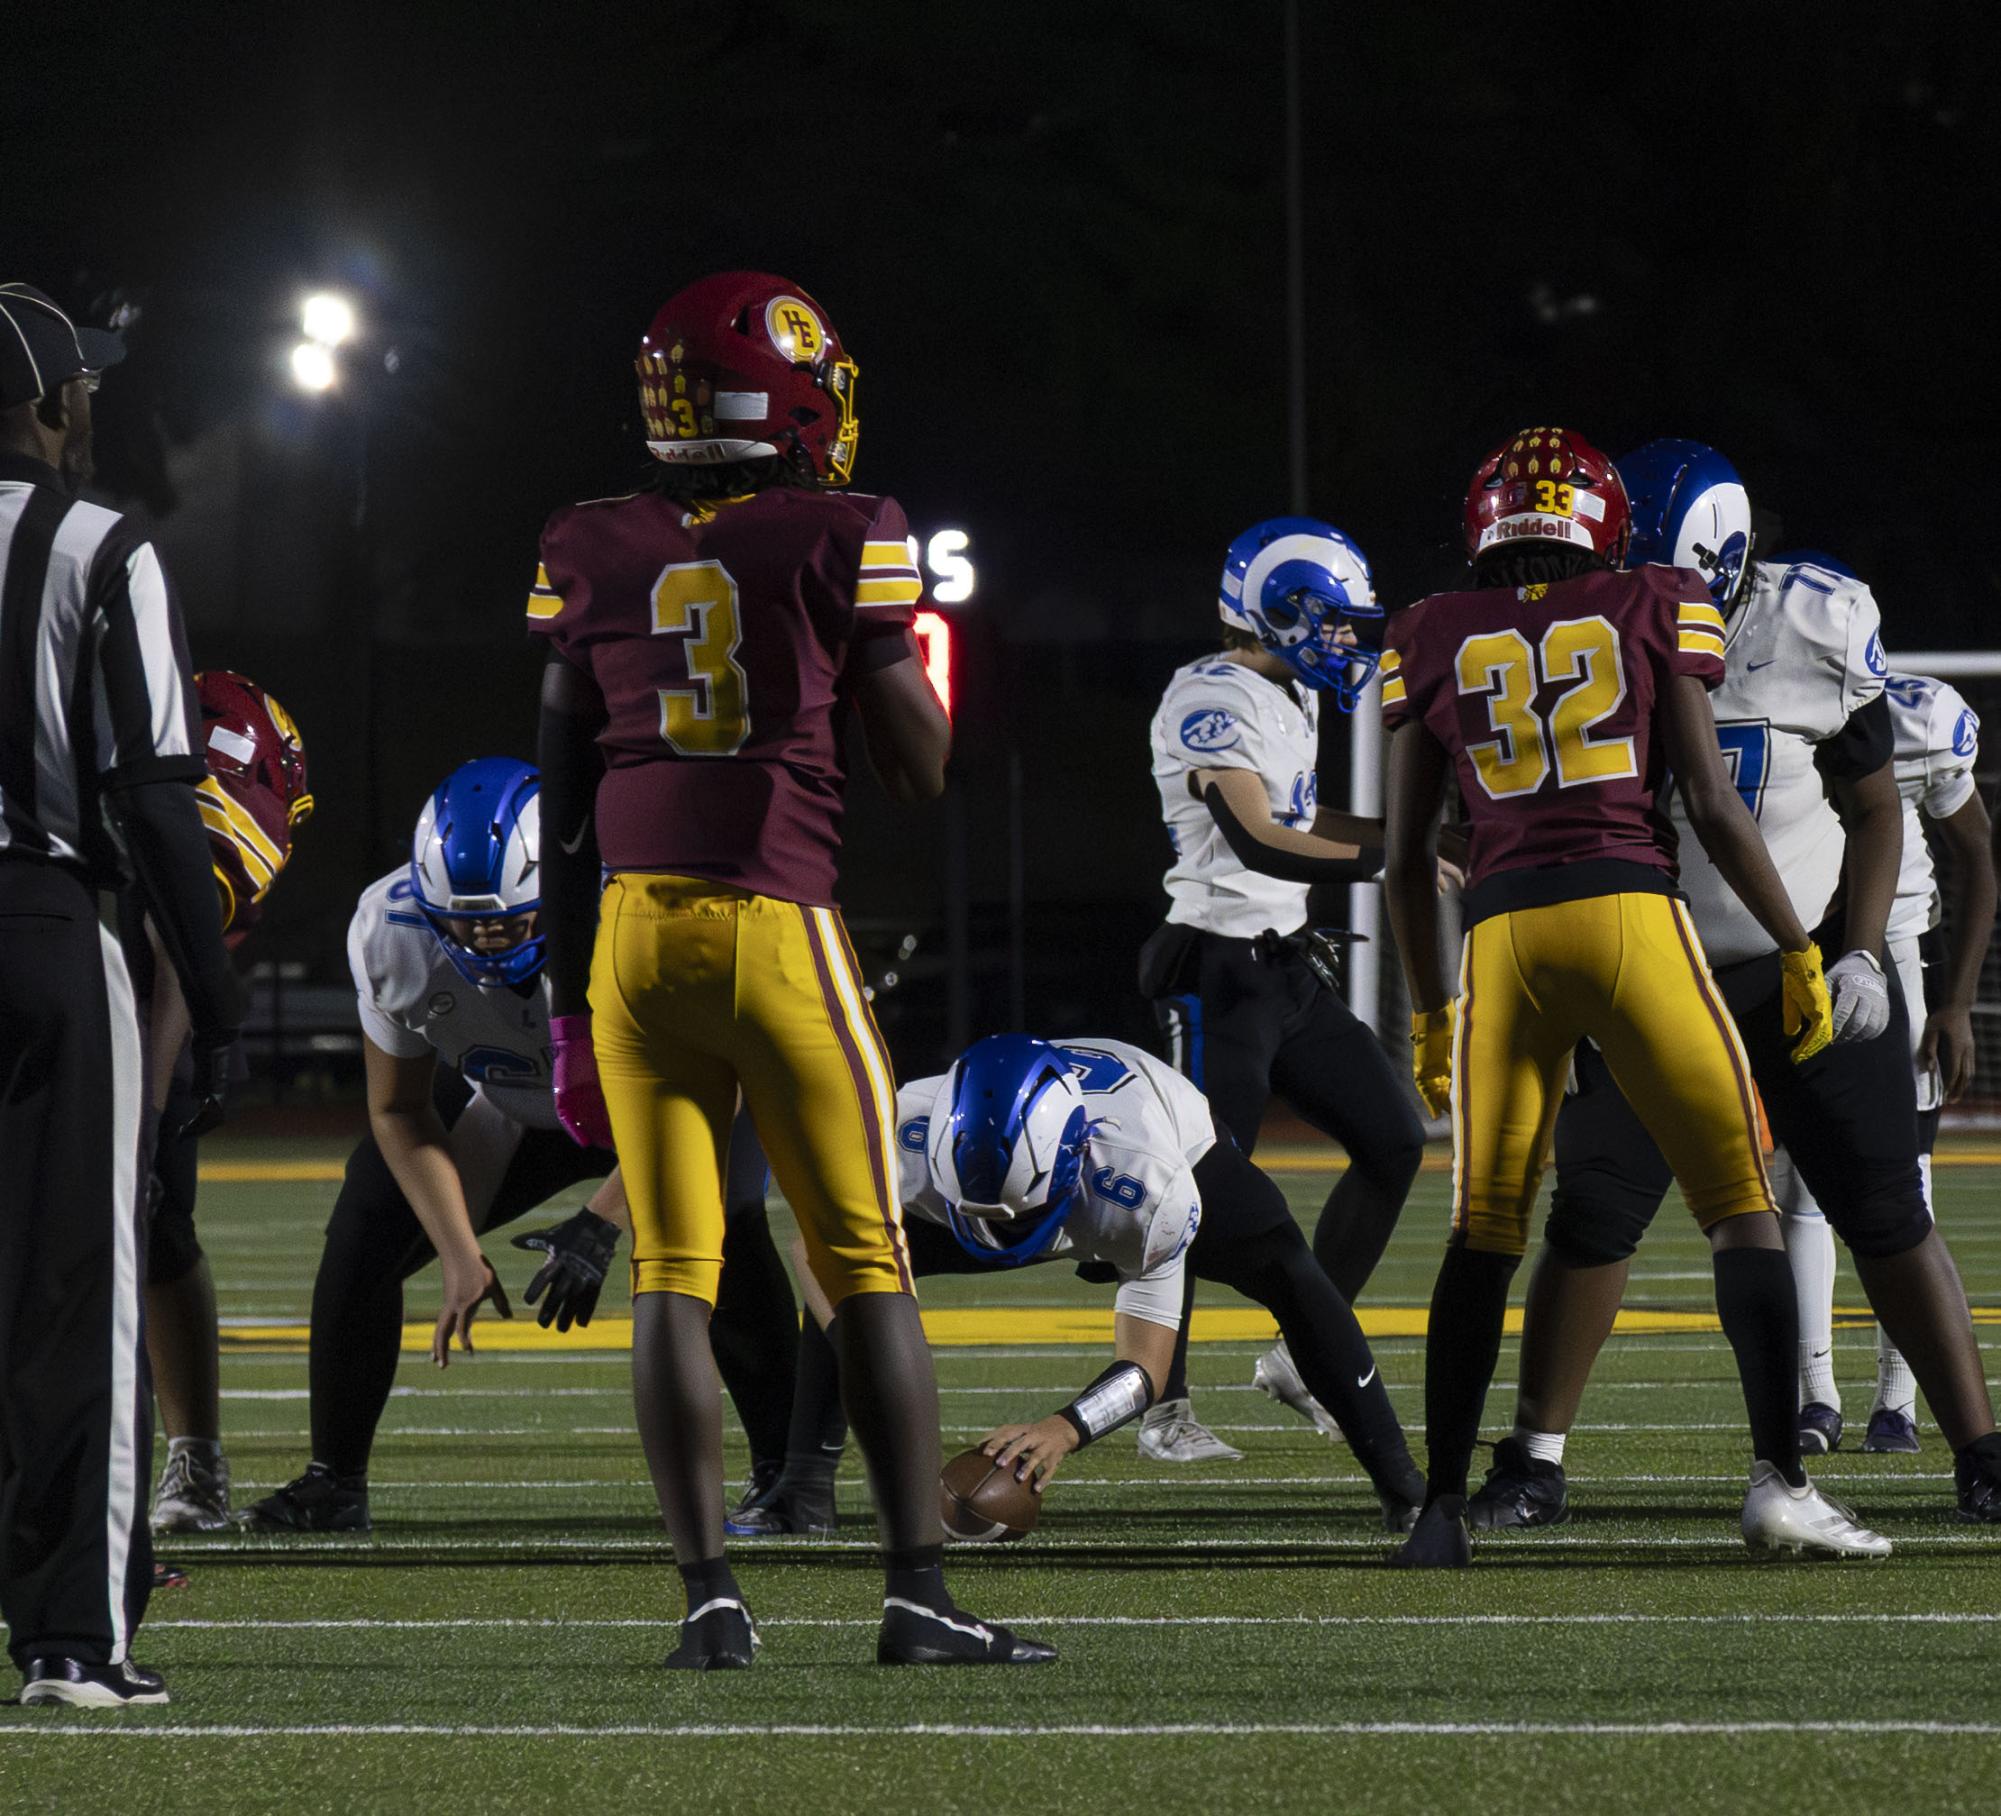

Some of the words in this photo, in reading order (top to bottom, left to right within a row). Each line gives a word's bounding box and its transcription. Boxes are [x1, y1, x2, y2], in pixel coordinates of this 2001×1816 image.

[672, 399, 698, 438] 3
[1535, 479, 1575, 518] 33
[1496, 518, 1571, 540] Riddell
[650, 559, 751, 756] 3
[1454, 614, 1639, 800] 32
